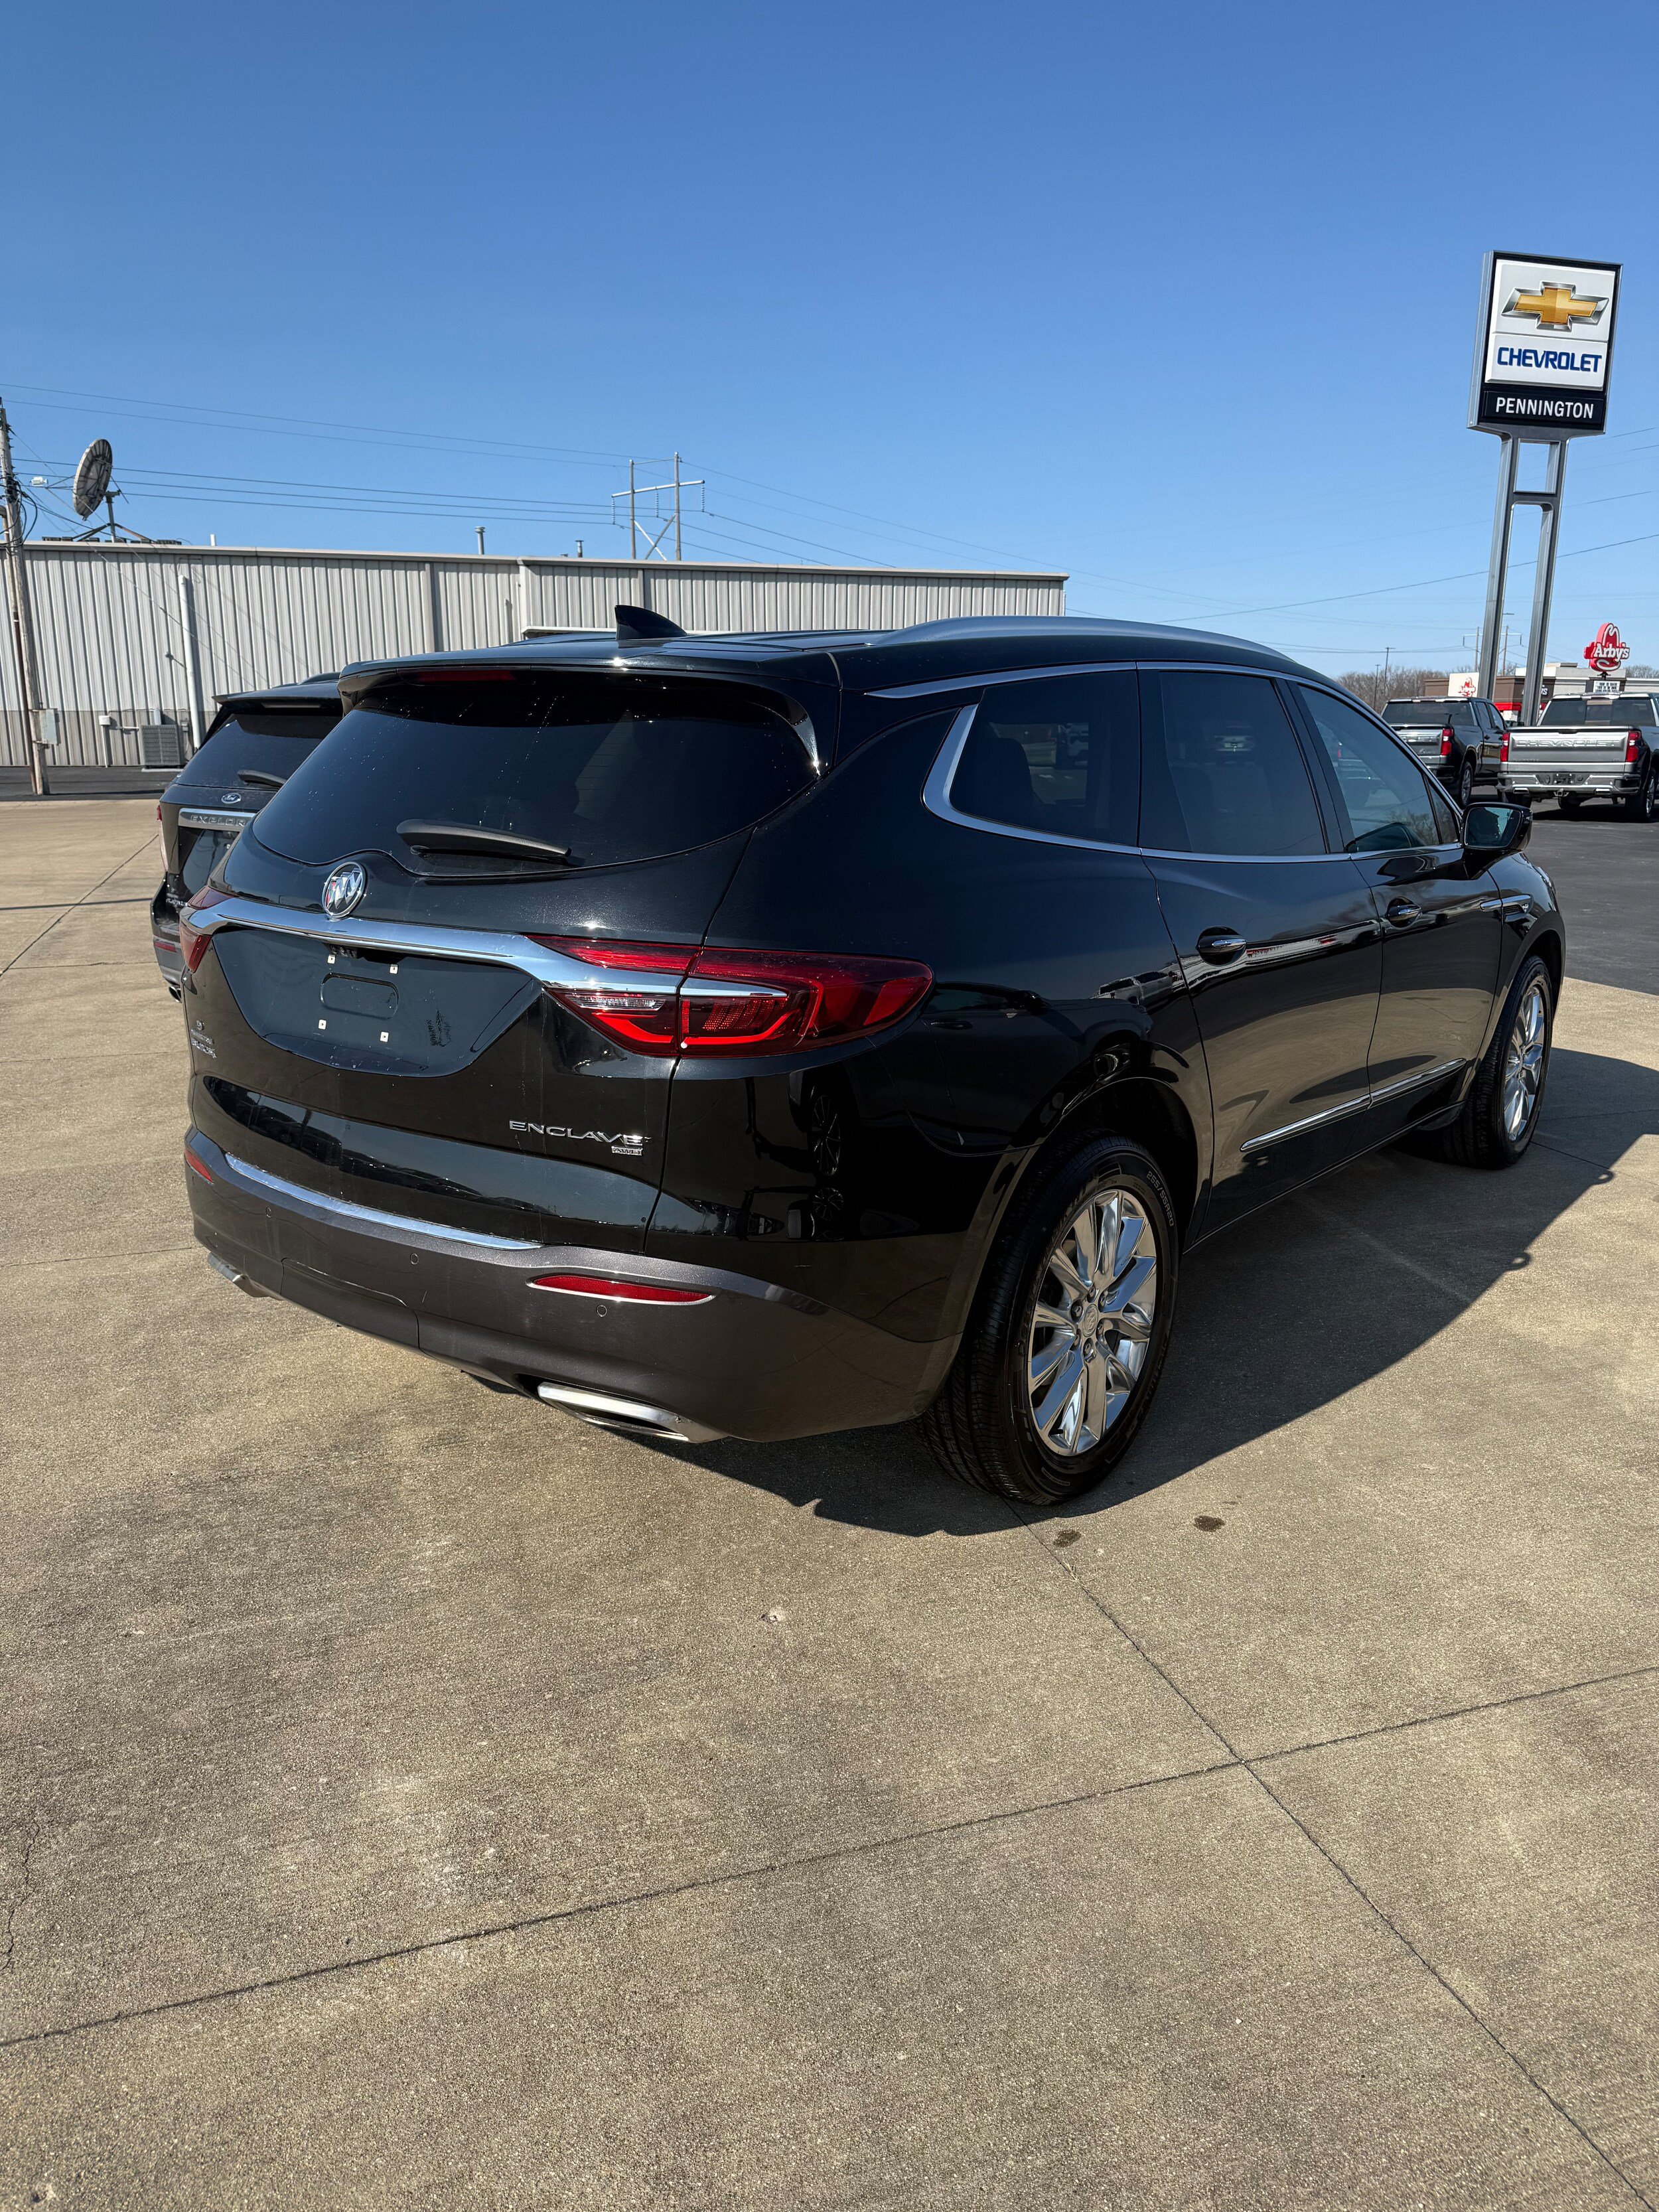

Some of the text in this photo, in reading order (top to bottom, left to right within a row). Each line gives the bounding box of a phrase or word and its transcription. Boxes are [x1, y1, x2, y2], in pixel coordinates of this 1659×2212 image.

[1497, 347, 1603, 372] CHEVROLET
[1495, 397, 1594, 419] PENNINGTON
[1593, 642, 1630, 662] Arby's
[1516, 739, 1620, 747] CHEVROLET
[509, 1120, 643, 1146] ENCLAVE
[613, 1146, 642, 1155] AWD
